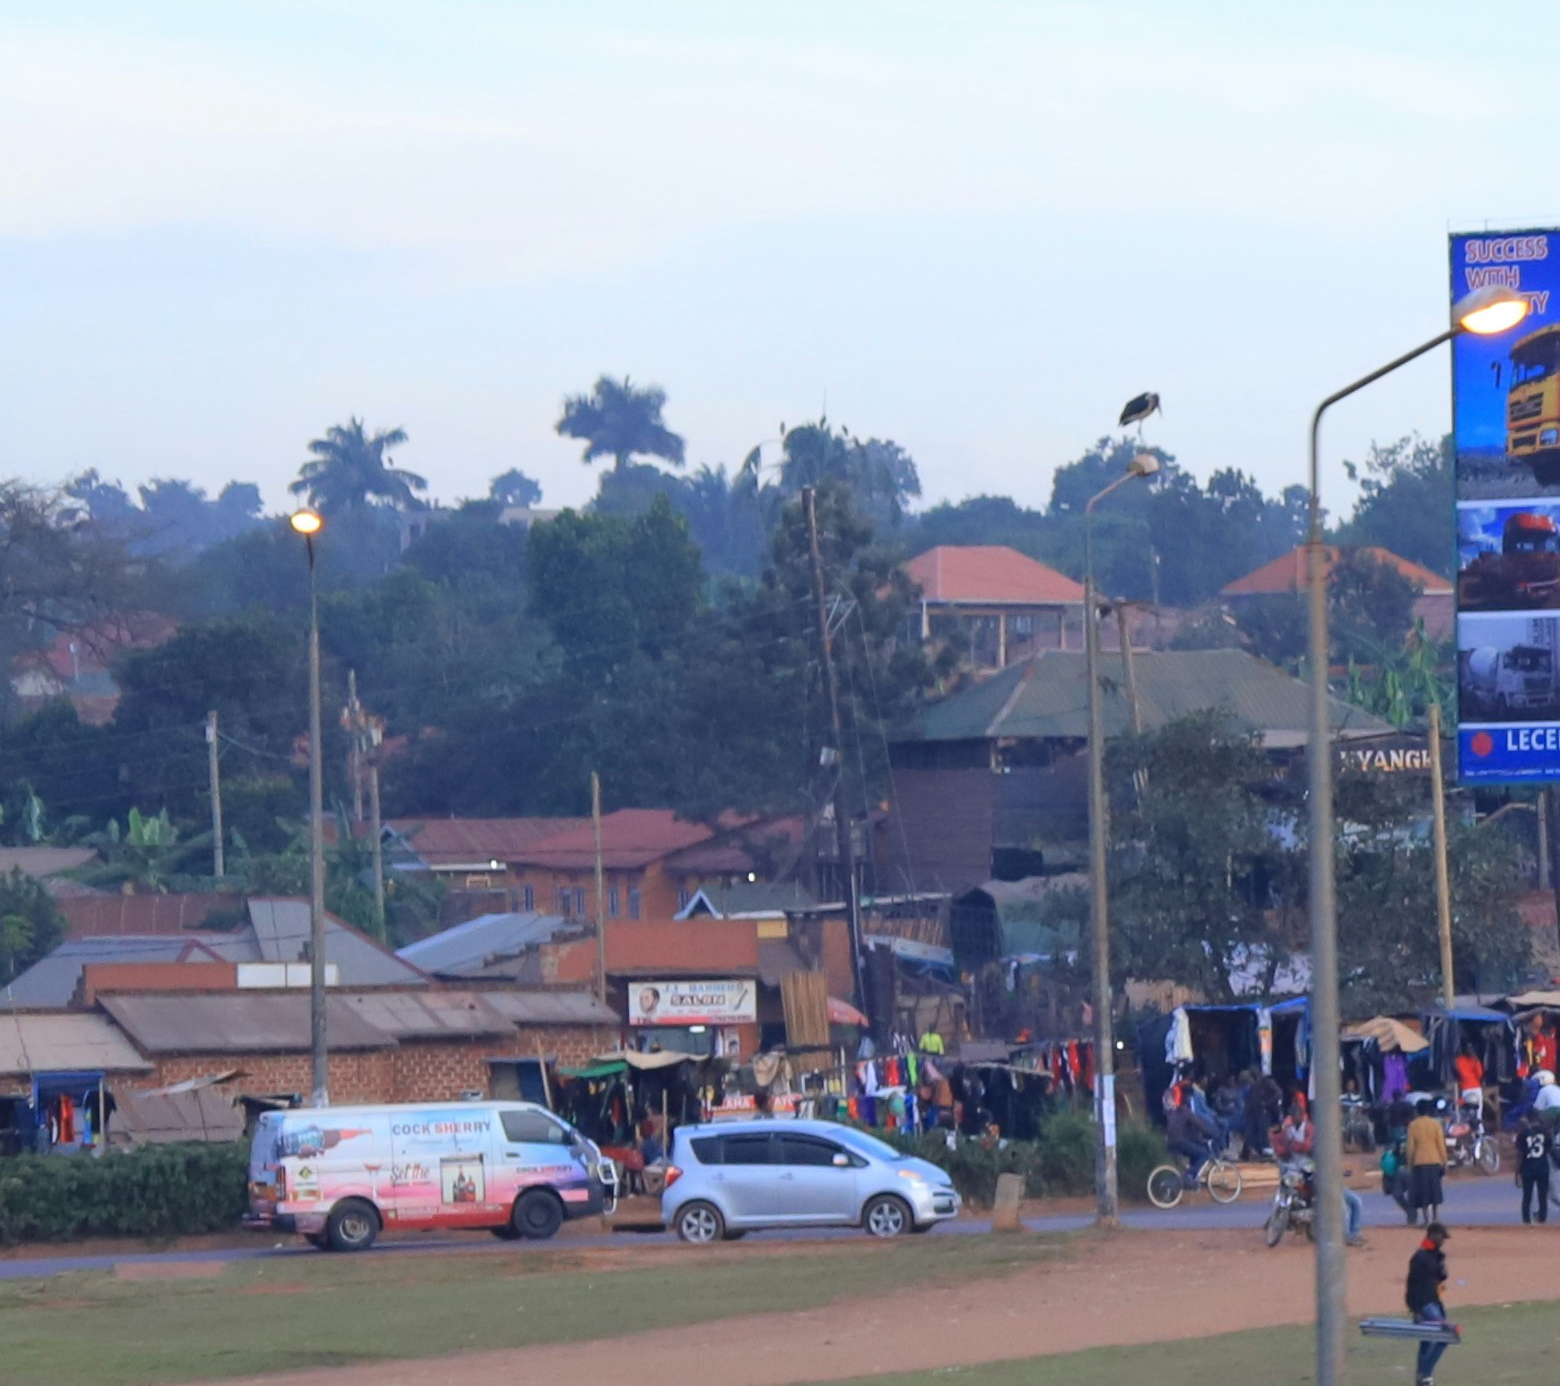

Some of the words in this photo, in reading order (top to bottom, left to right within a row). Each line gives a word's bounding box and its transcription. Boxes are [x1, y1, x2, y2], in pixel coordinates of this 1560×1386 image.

[1465, 236, 1549, 263] SUCCESS
[392, 1123, 431, 1136] COCK
[434, 1121, 491, 1135] SHERRY
